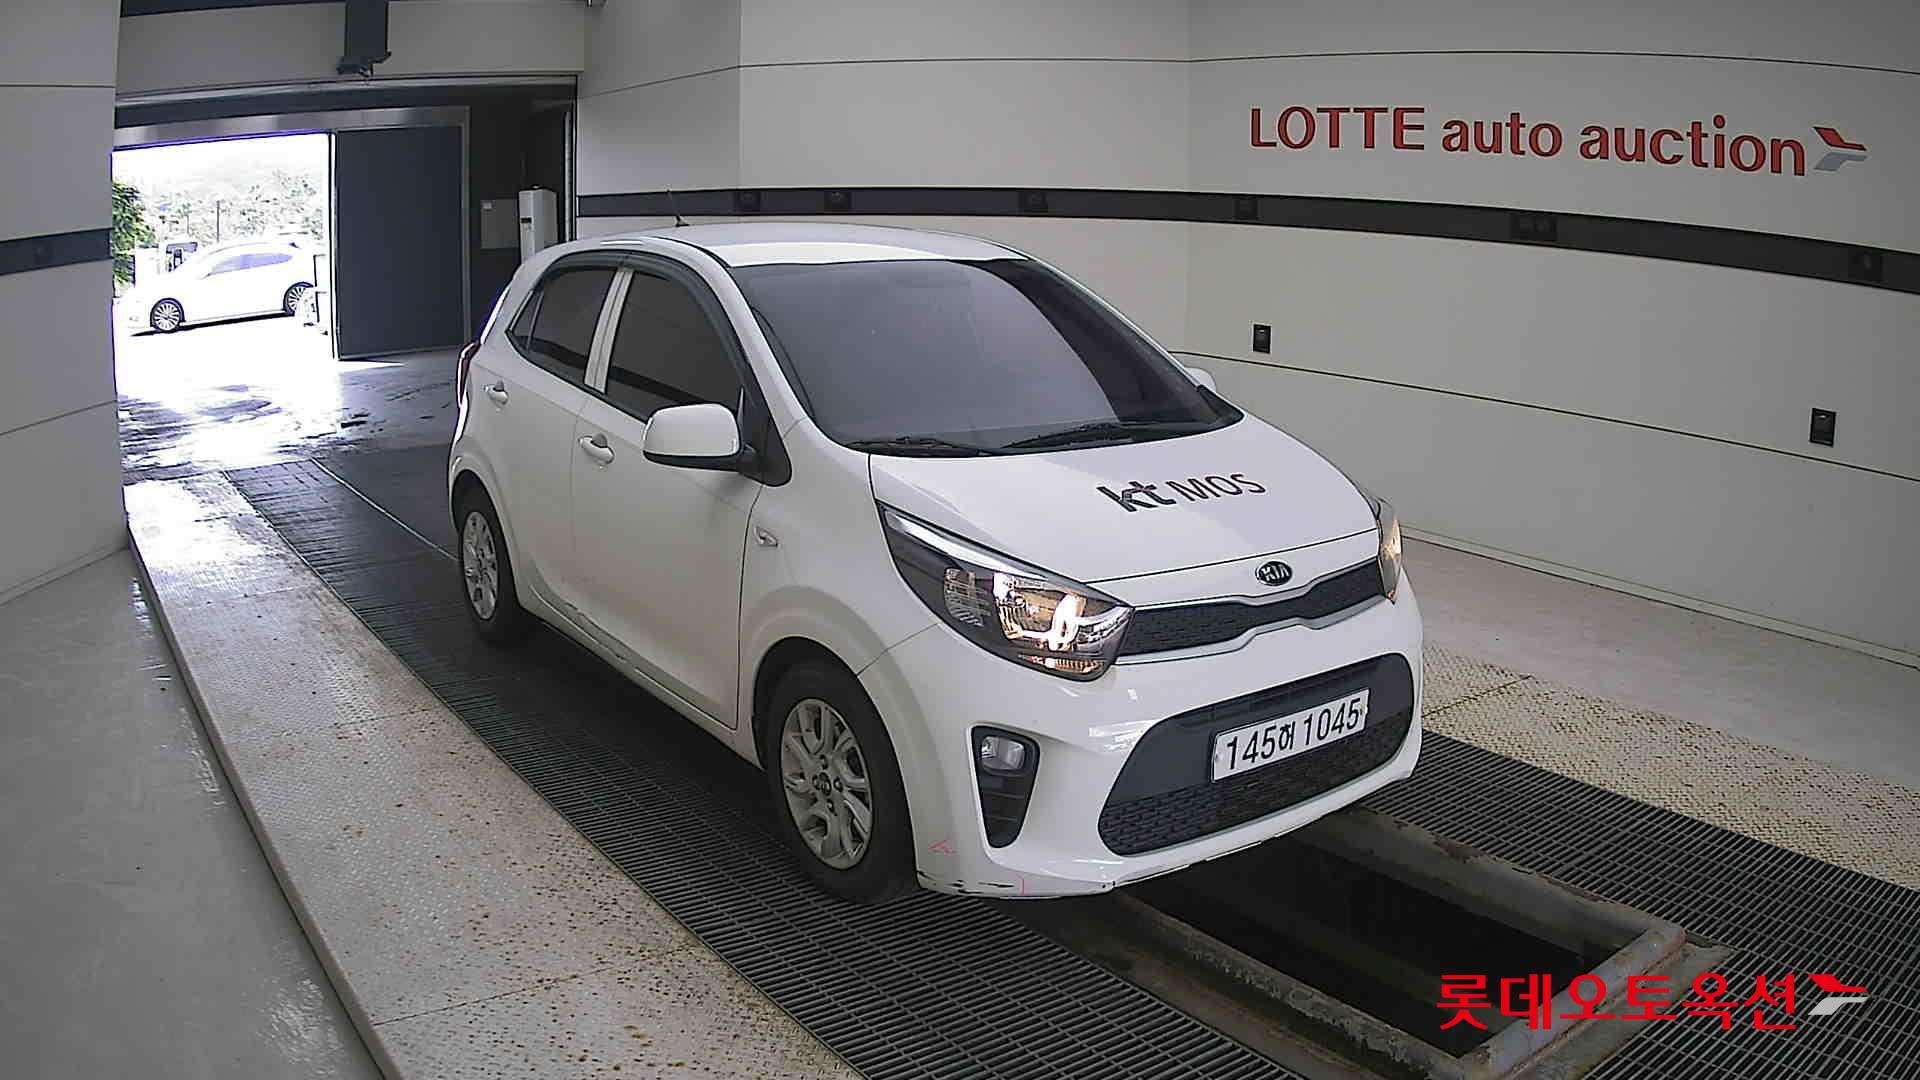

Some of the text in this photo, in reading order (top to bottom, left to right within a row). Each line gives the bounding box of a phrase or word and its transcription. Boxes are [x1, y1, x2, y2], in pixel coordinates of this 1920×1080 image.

[1250, 106, 1806, 177] LOTTE auto auction
[1096, 473, 1266, 512] kt MOS
[1259, 562, 1291, 582] KIA
[1227, 697, 1361, 769] 145허 1045
